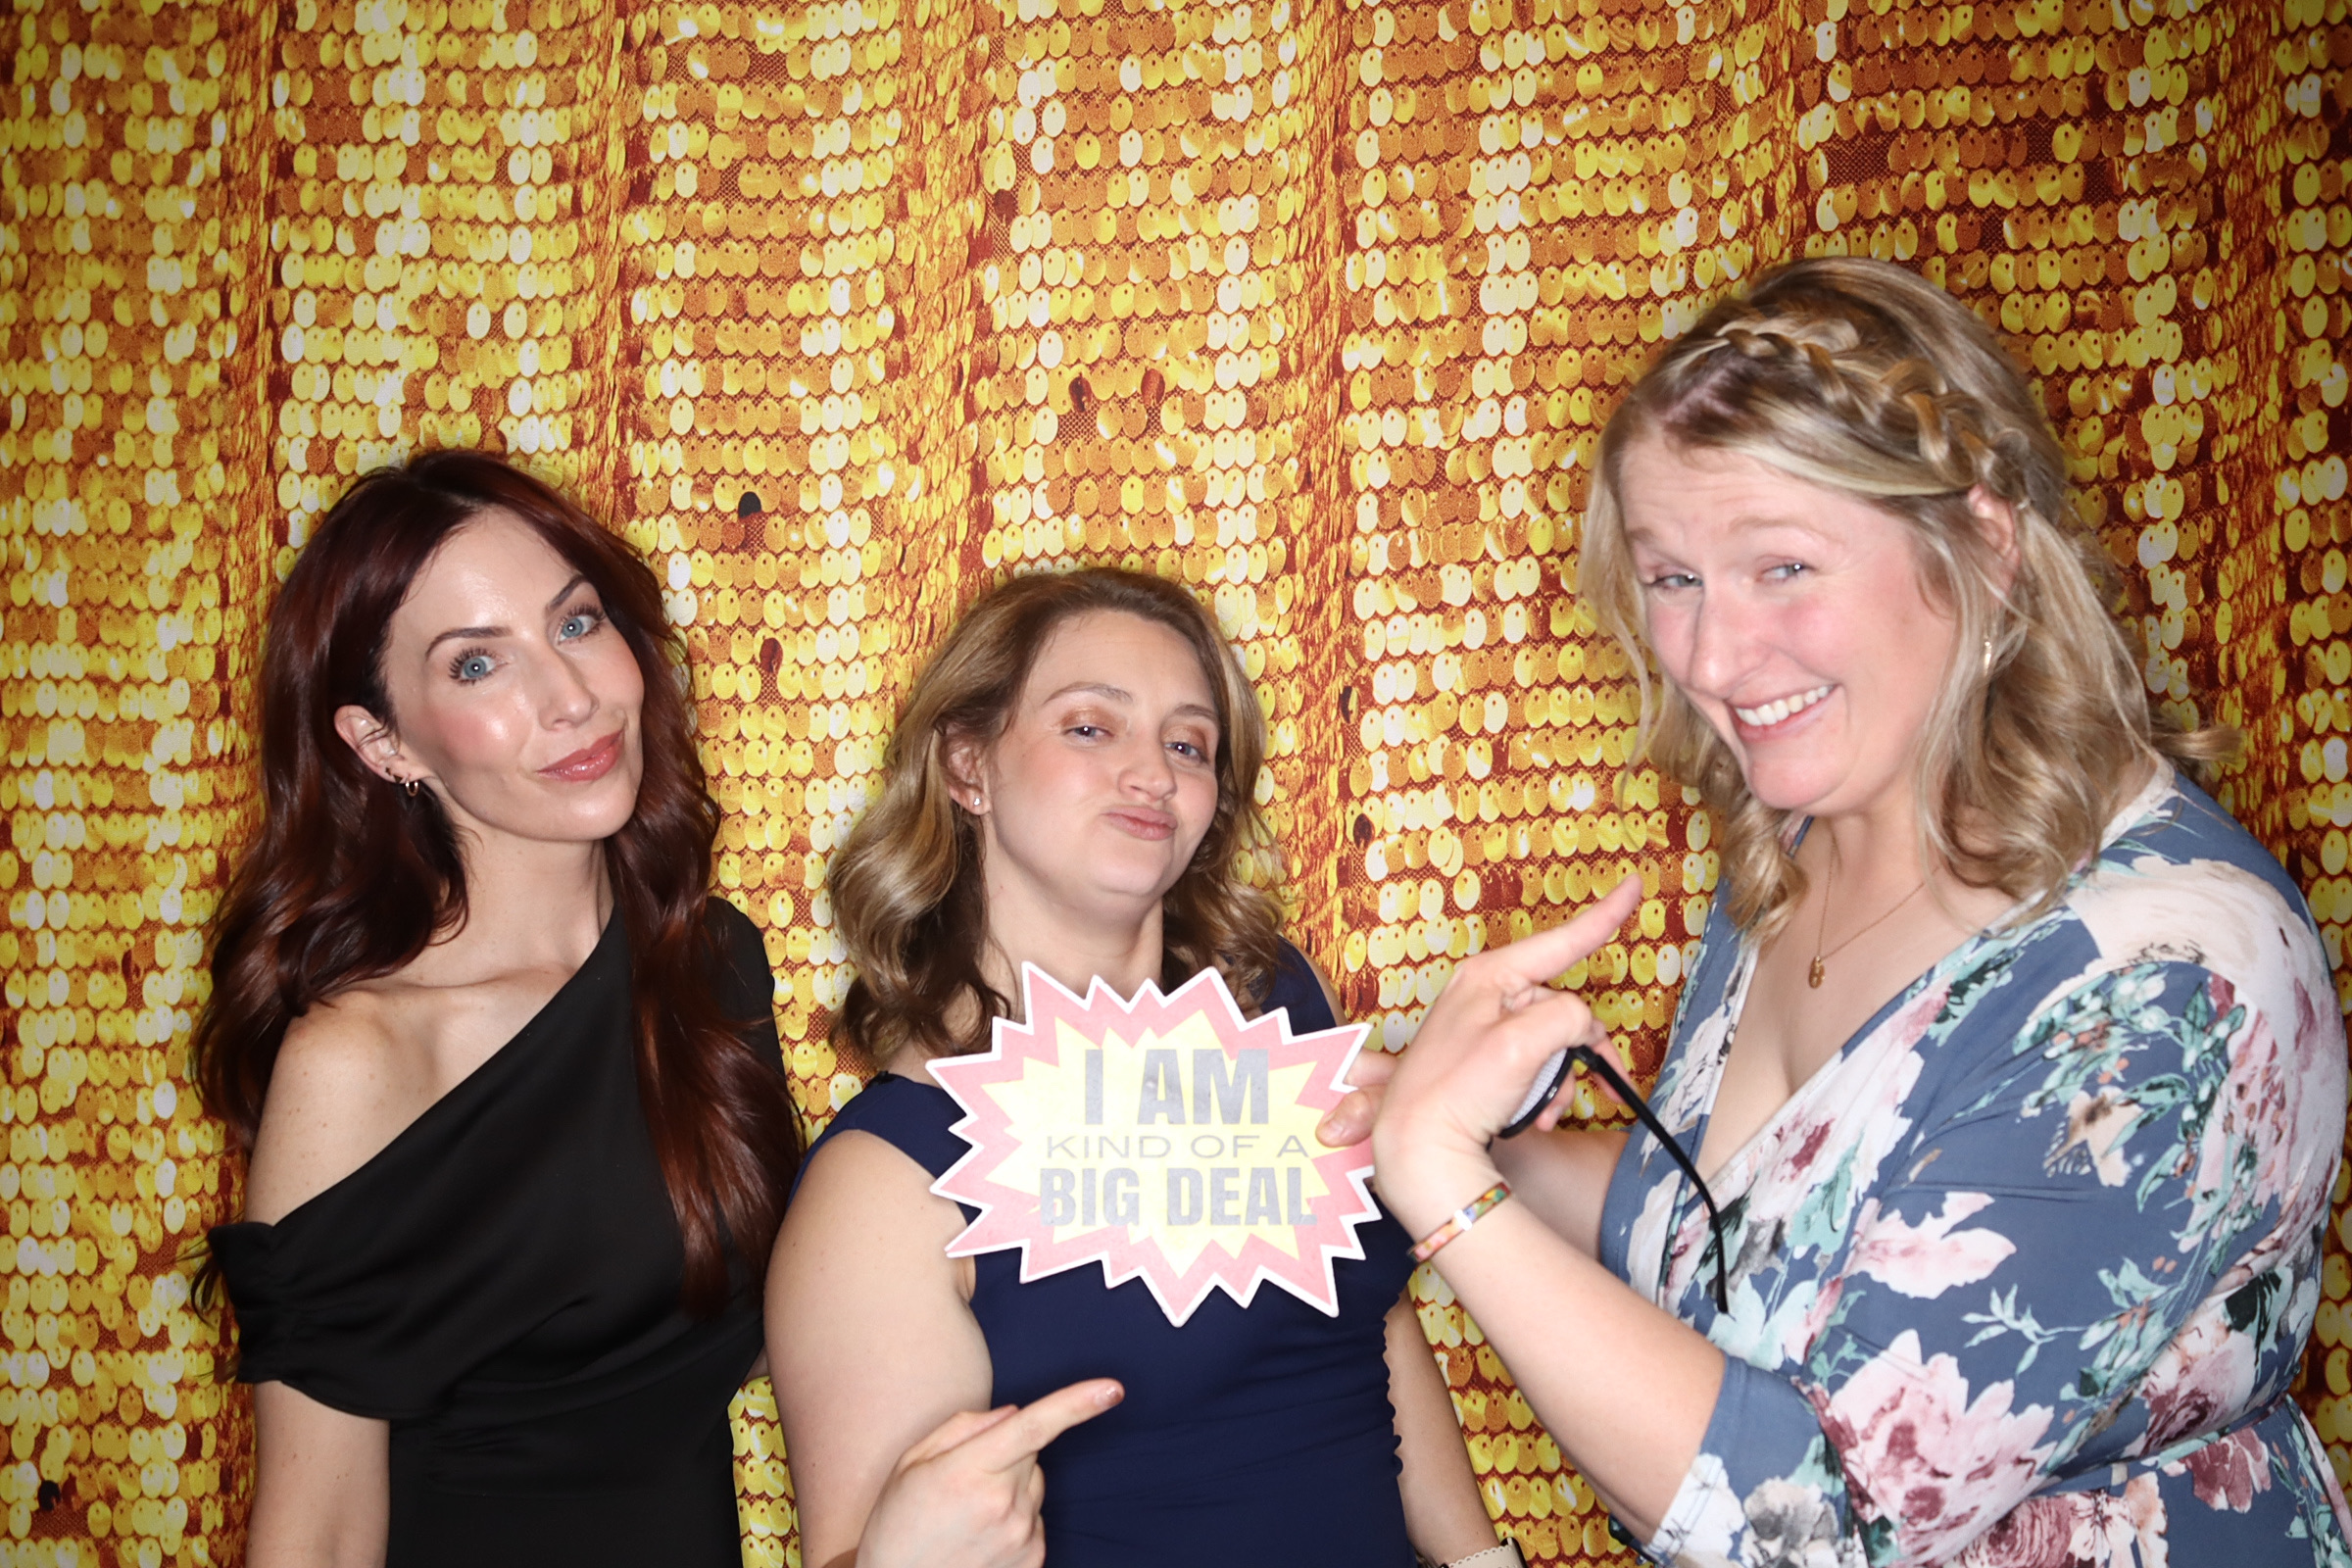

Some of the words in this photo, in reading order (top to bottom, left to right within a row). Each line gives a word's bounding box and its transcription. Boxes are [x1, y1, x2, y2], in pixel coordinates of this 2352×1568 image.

[1084, 1049, 1103, 1125] I
[1137, 1049, 1269, 1125] AM
[1047, 1135, 1172, 1158] KIND
[1190, 1135, 1261, 1158] OF
[1276, 1135, 1309, 1158] A
[1040, 1167, 1140, 1227] BIG
[1166, 1166, 1317, 1226] DEAL
